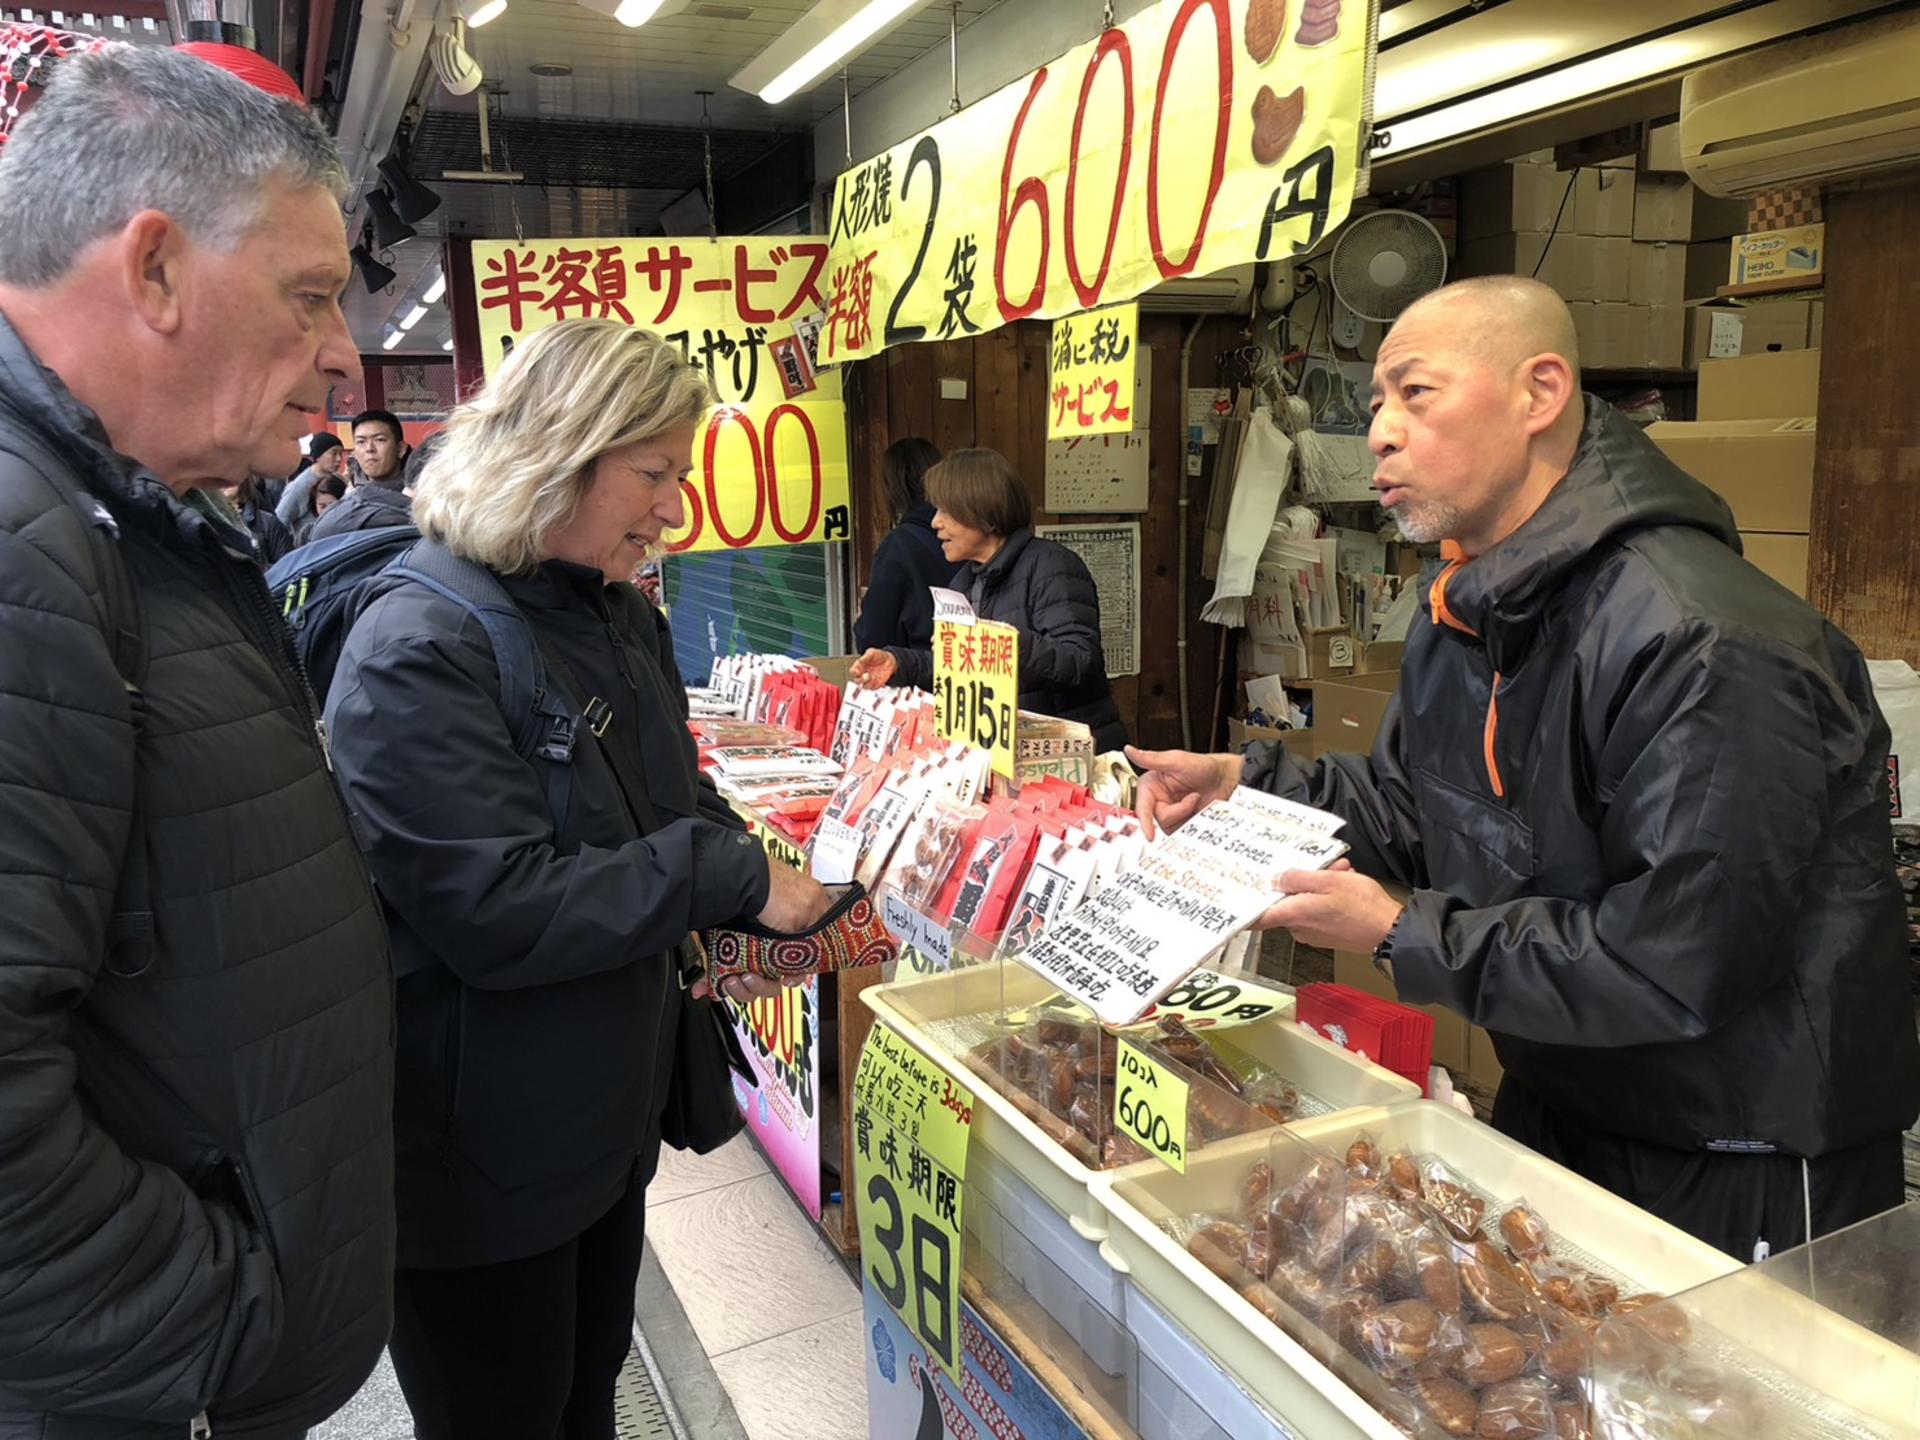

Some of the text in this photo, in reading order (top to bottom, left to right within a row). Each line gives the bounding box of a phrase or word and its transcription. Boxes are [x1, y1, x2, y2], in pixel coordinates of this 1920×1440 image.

[830, 158, 892, 248] 人形焼
[884, 136, 982, 346] 2袋
[1747, 261, 1774, 271] HEIKO
[481, 243, 832, 331] 半額サービス
[827, 251, 877, 359] 半額
[1052, 377, 1130, 427] サービス
[941, 622, 1014, 678] 賞味期限
[945, 675, 1011, 750] 1月15日
[886, 896, 918, 942] Freshly
[861, 1050, 928, 1120] 可以吃三天
[870, 1024, 882, 1049] The
[882, 1034, 899, 1064] best
[900, 1048, 928, 1087] before
[930, 1075, 940, 1094] is
[1119, 1086, 1181, 1160] 600円
[855, 1105, 960, 1233] 賞味期限
[867, 1174, 953, 1367] 3日
